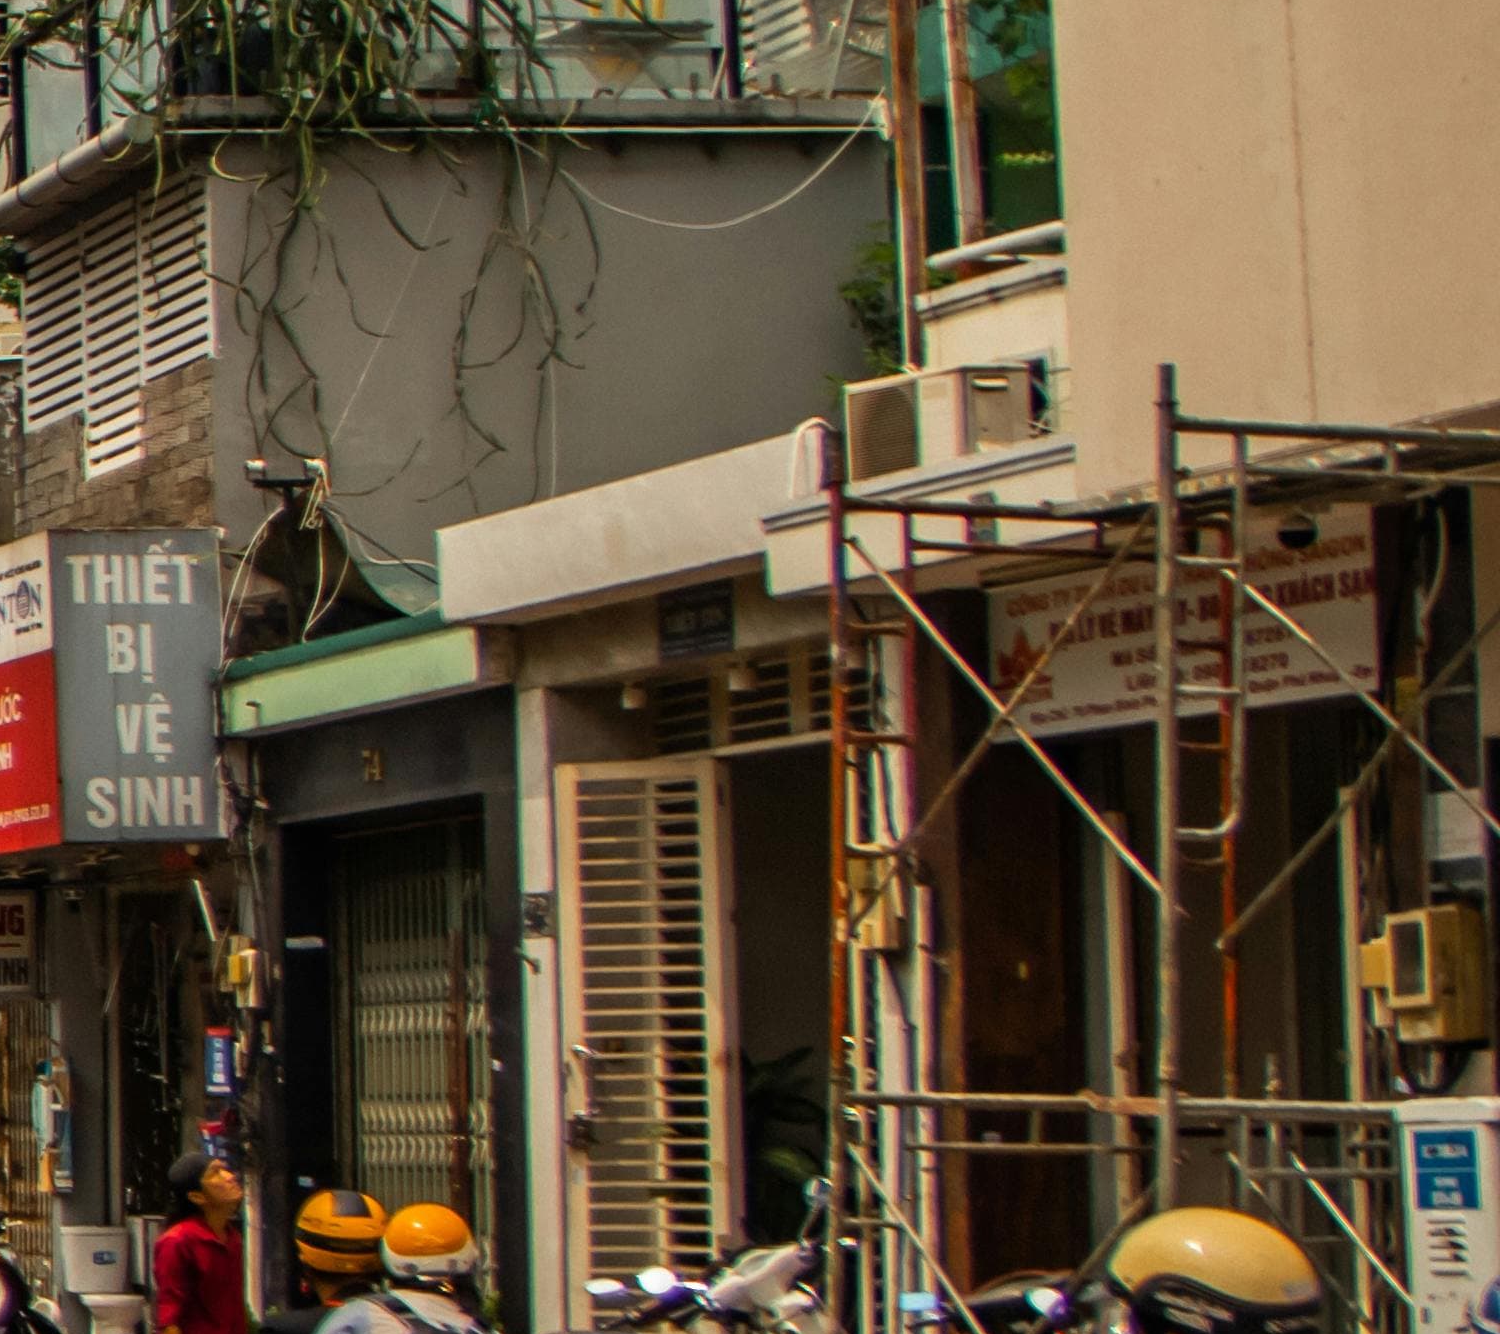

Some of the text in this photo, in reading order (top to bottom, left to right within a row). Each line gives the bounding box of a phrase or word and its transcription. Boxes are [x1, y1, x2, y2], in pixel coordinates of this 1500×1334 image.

[65, 539, 199, 607] THIẾT
[106, 622, 154, 685] BỊ
[116, 692, 175, 763] VỆ
[86, 777, 203, 829] SINH
